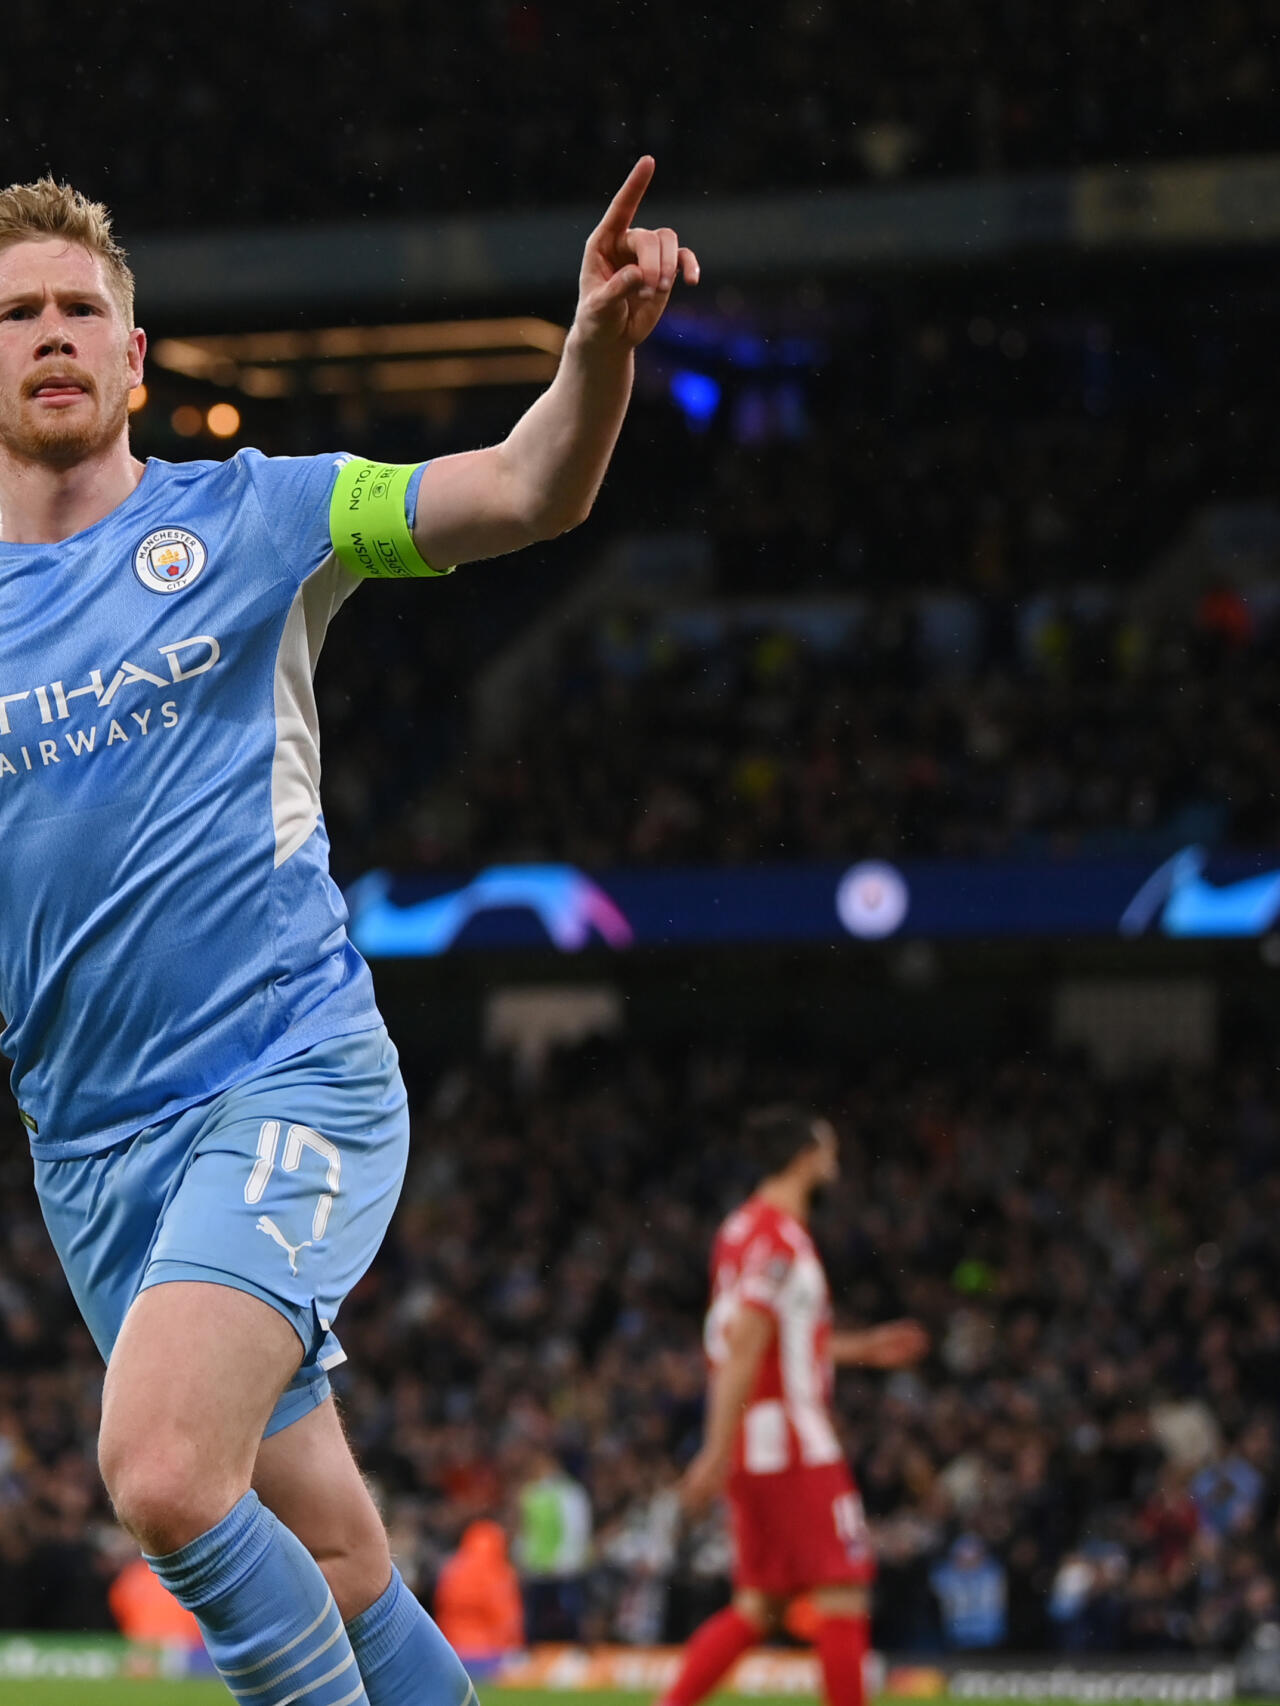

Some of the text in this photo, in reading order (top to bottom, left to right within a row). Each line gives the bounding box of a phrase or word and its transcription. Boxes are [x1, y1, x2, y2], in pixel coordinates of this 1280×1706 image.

[355, 469, 371, 485] TO
[349, 487, 362, 511] NO
[139, 532, 197, 559] MANCHESTER
[351, 532, 381, 575] RACISM
[377, 540, 410, 576] SPECT
[167, 579, 187, 590] CITY
[244, 1121, 341, 1240] 17
